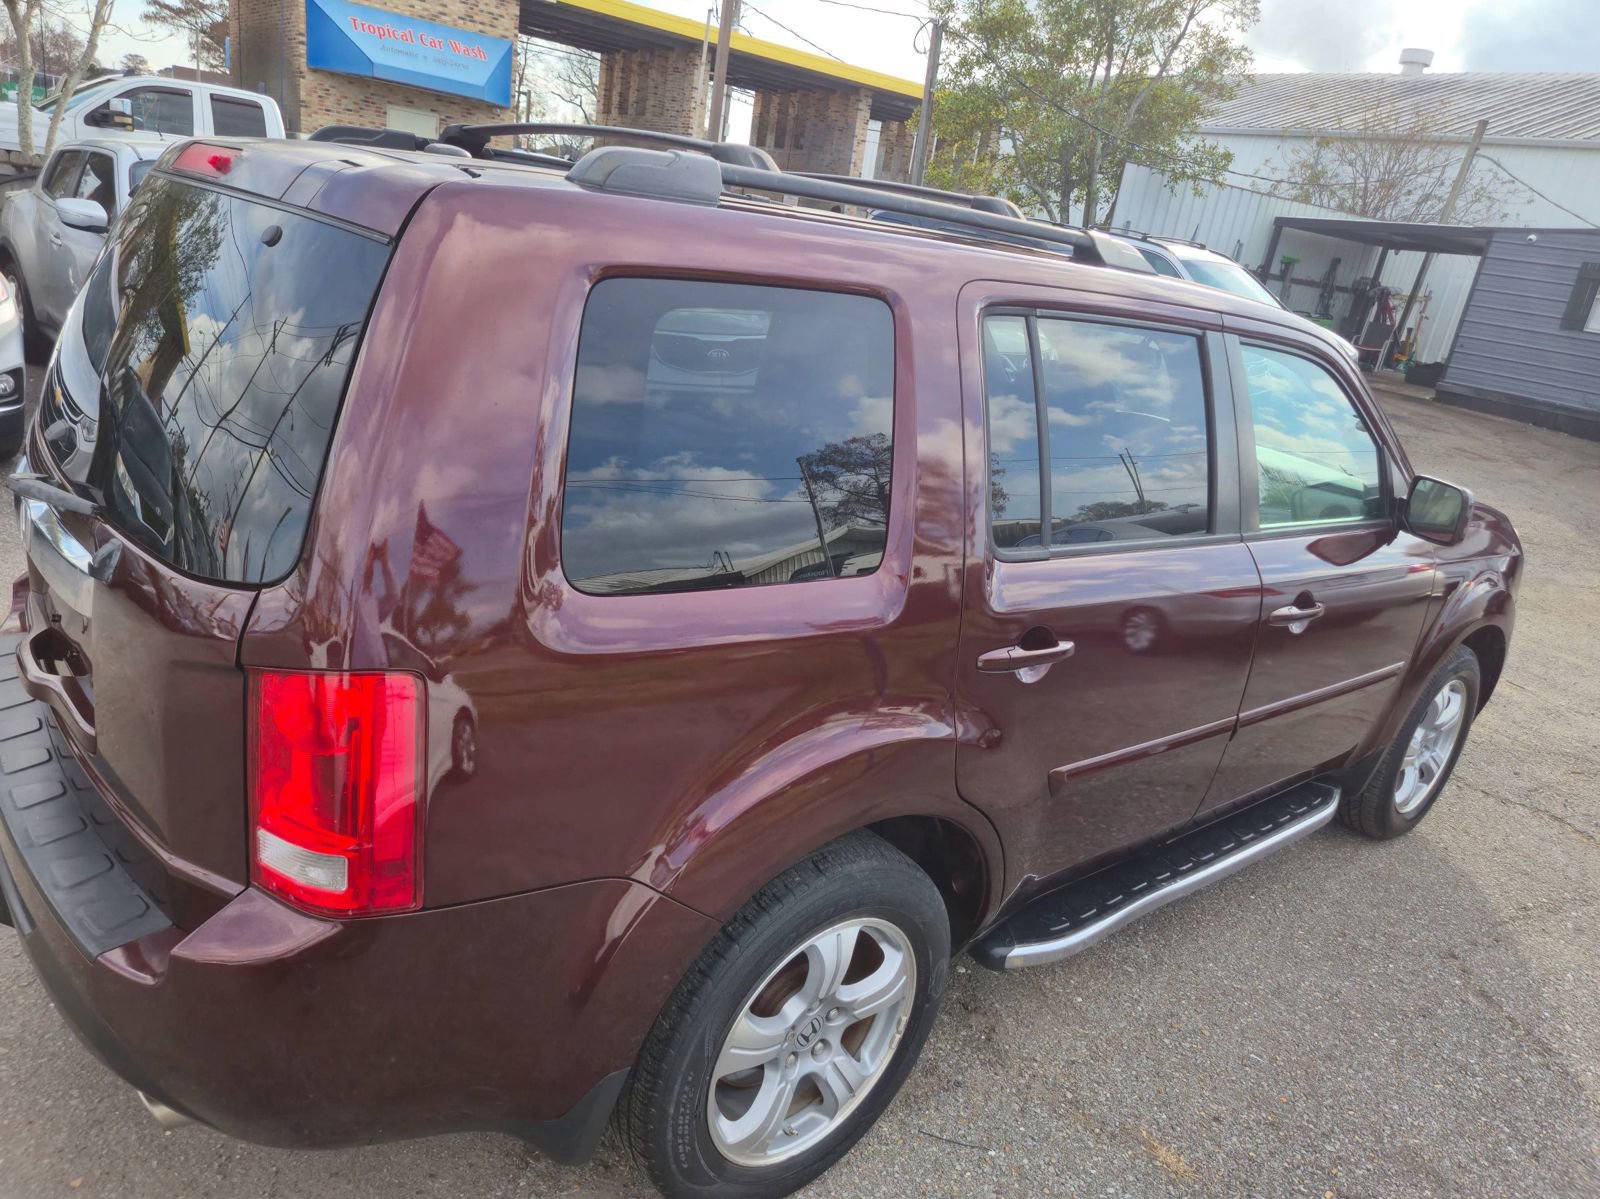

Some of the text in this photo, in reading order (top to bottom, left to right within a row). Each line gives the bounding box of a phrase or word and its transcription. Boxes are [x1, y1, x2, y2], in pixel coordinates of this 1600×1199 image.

[349, 16, 487, 60] Tropical Car Wash
